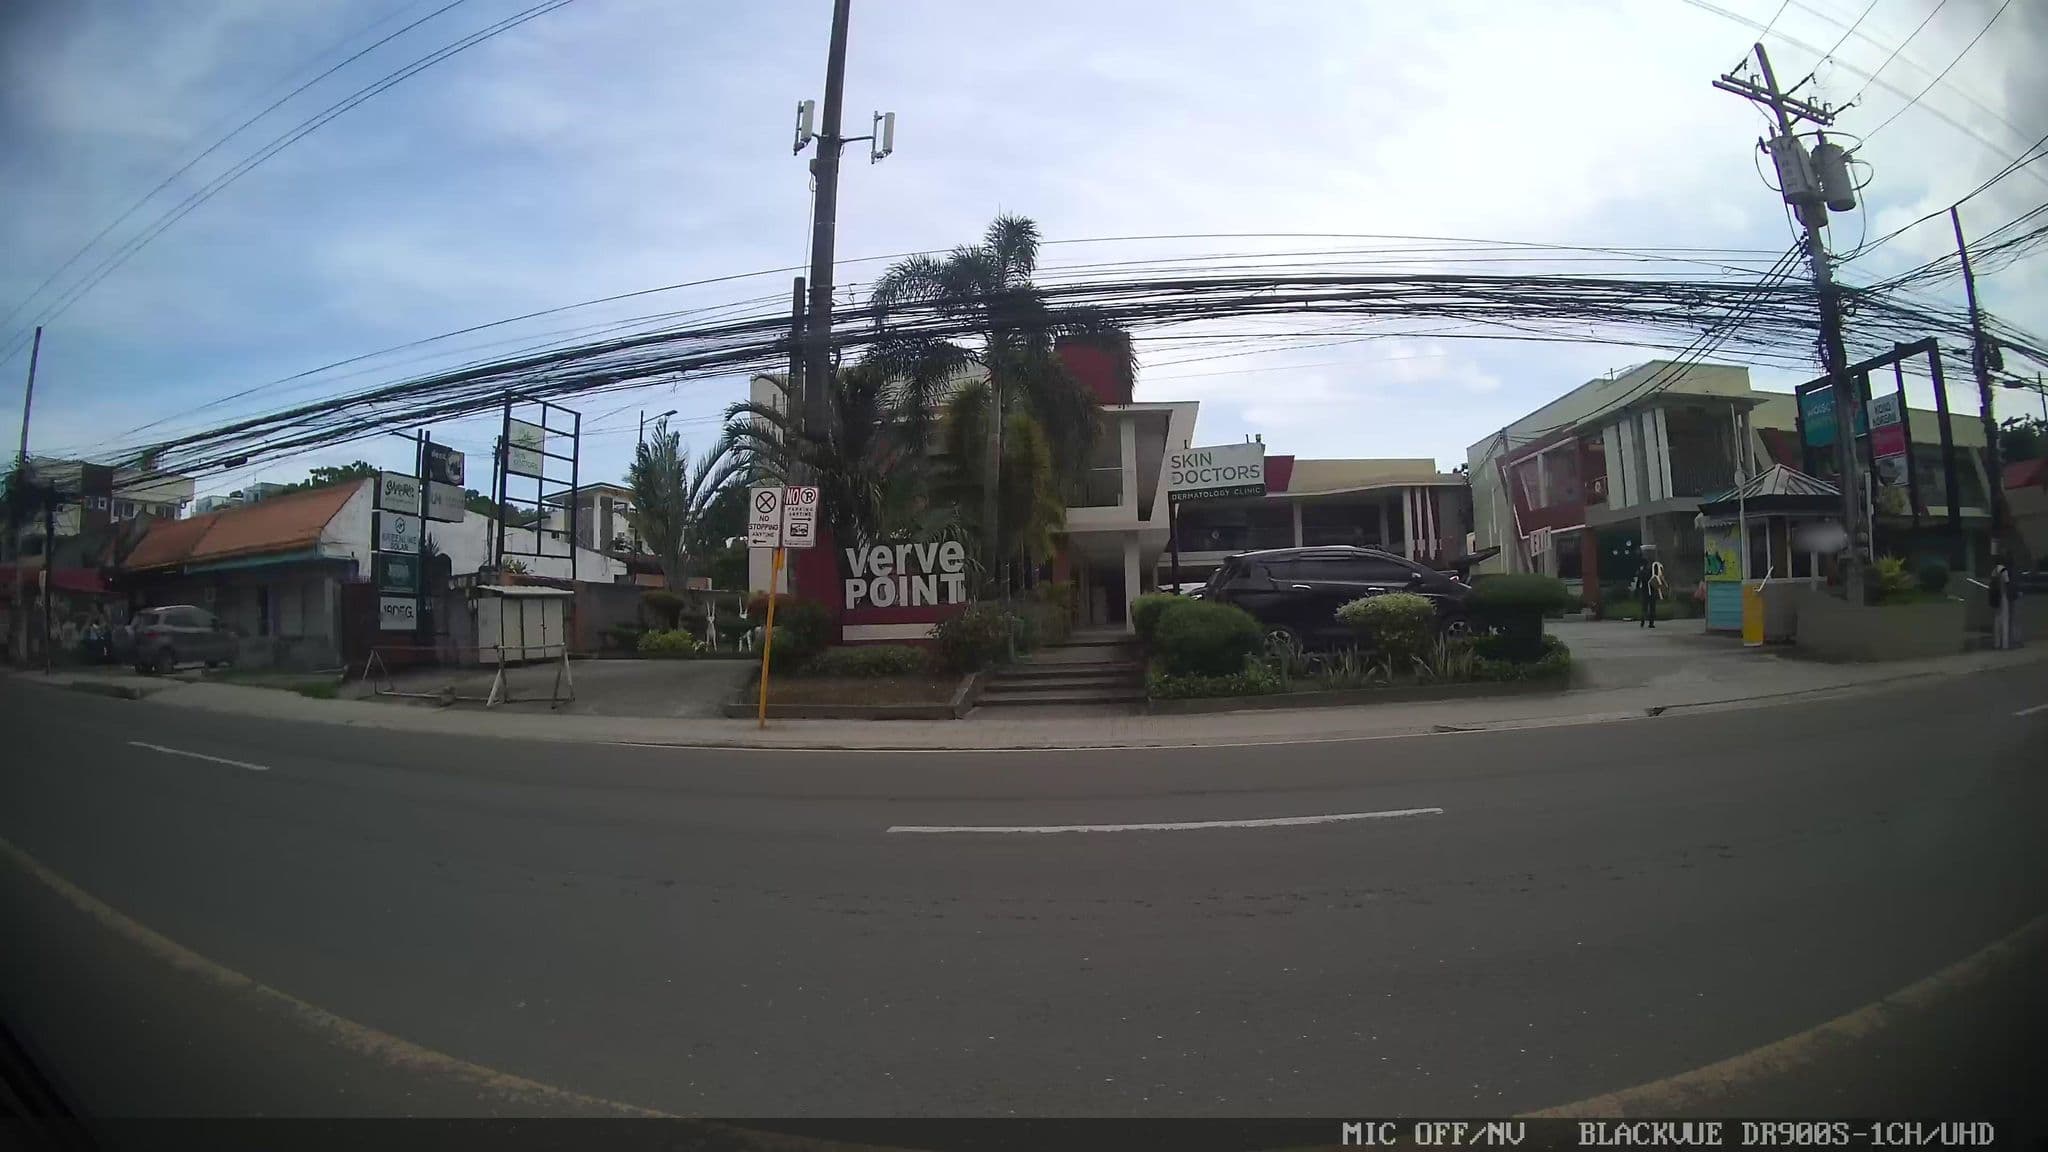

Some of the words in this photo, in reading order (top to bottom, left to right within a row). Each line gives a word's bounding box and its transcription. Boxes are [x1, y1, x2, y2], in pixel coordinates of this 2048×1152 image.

[1171, 451, 1213, 469] SKIN
[1171, 464, 1261, 485] DOCTORS
[785, 488, 800, 505] NO
[1171, 489, 1230, 501] DERMATOLOGY
[1233, 487, 1262, 496] CLINIC
[759, 514, 770, 522] NO
[748, 523, 779, 531] STOPPING
[845, 541, 965, 577] verve
[845, 573, 966, 609] POINT
